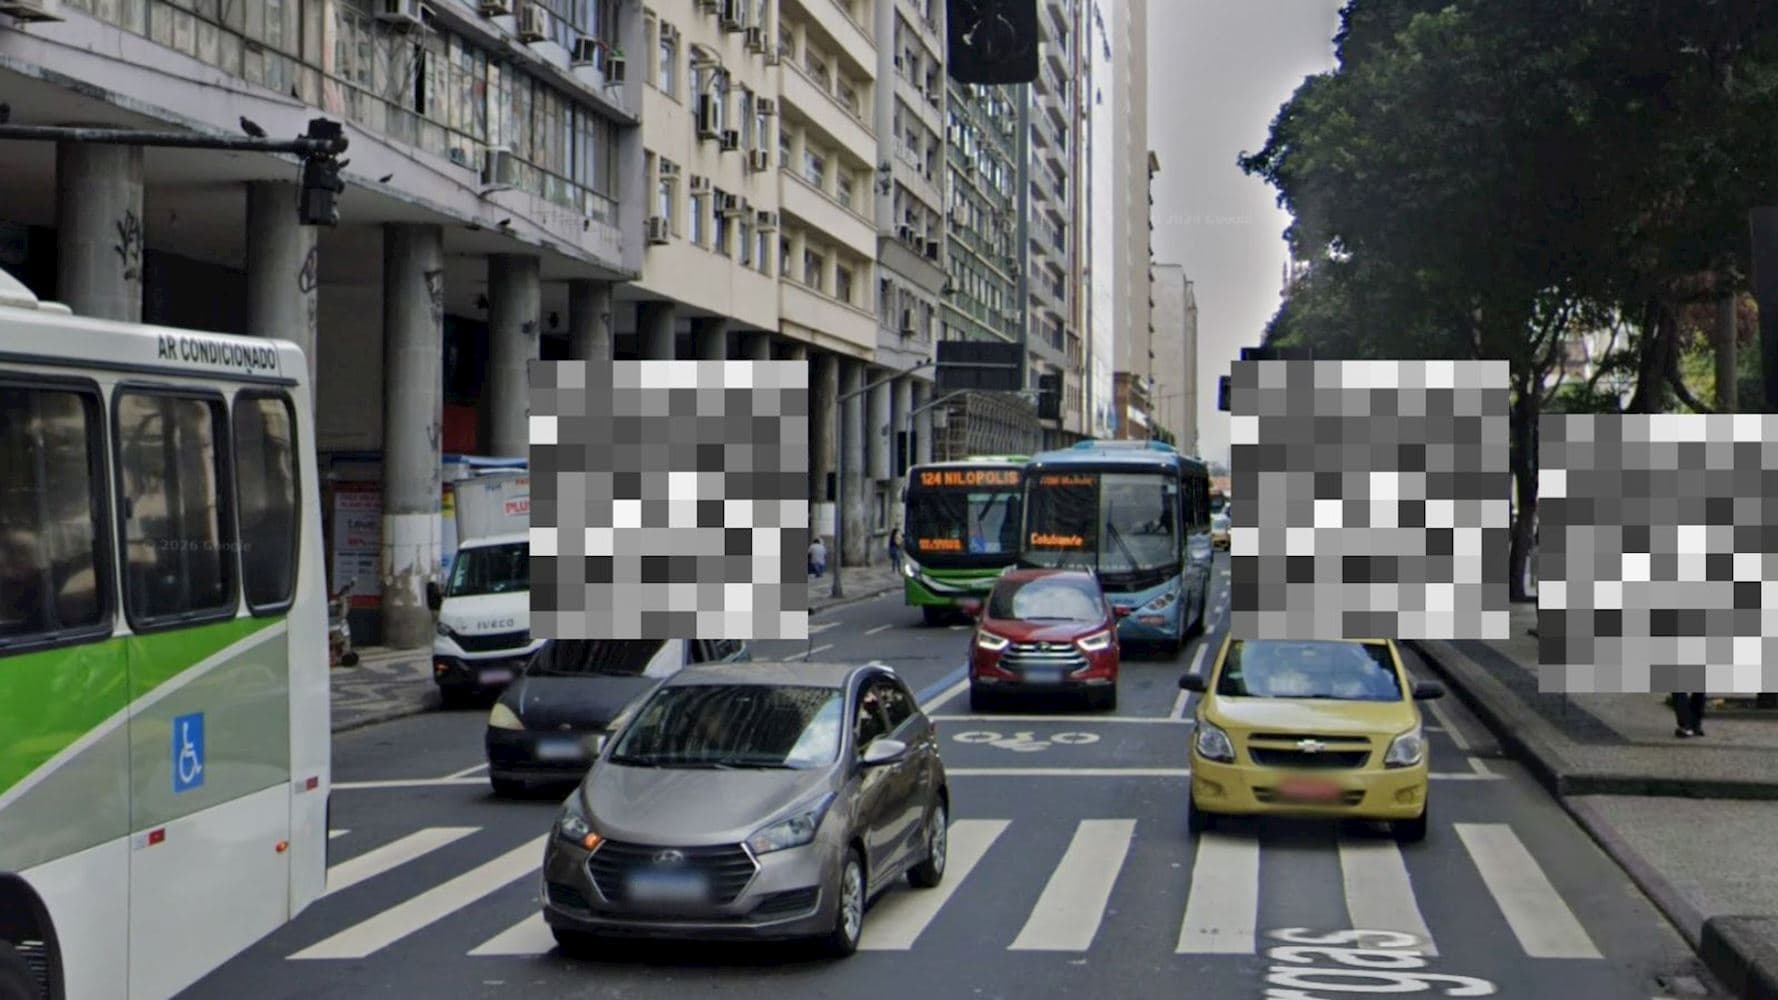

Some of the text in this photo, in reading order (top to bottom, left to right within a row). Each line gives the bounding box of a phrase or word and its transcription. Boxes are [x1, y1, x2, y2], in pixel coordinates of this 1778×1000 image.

[158, 334, 276, 369] AR CONDICIONADO
[921, 472, 942, 486] 124
[505, 501, 529, 514] PLU
[477, 617, 514, 630] IVECO
